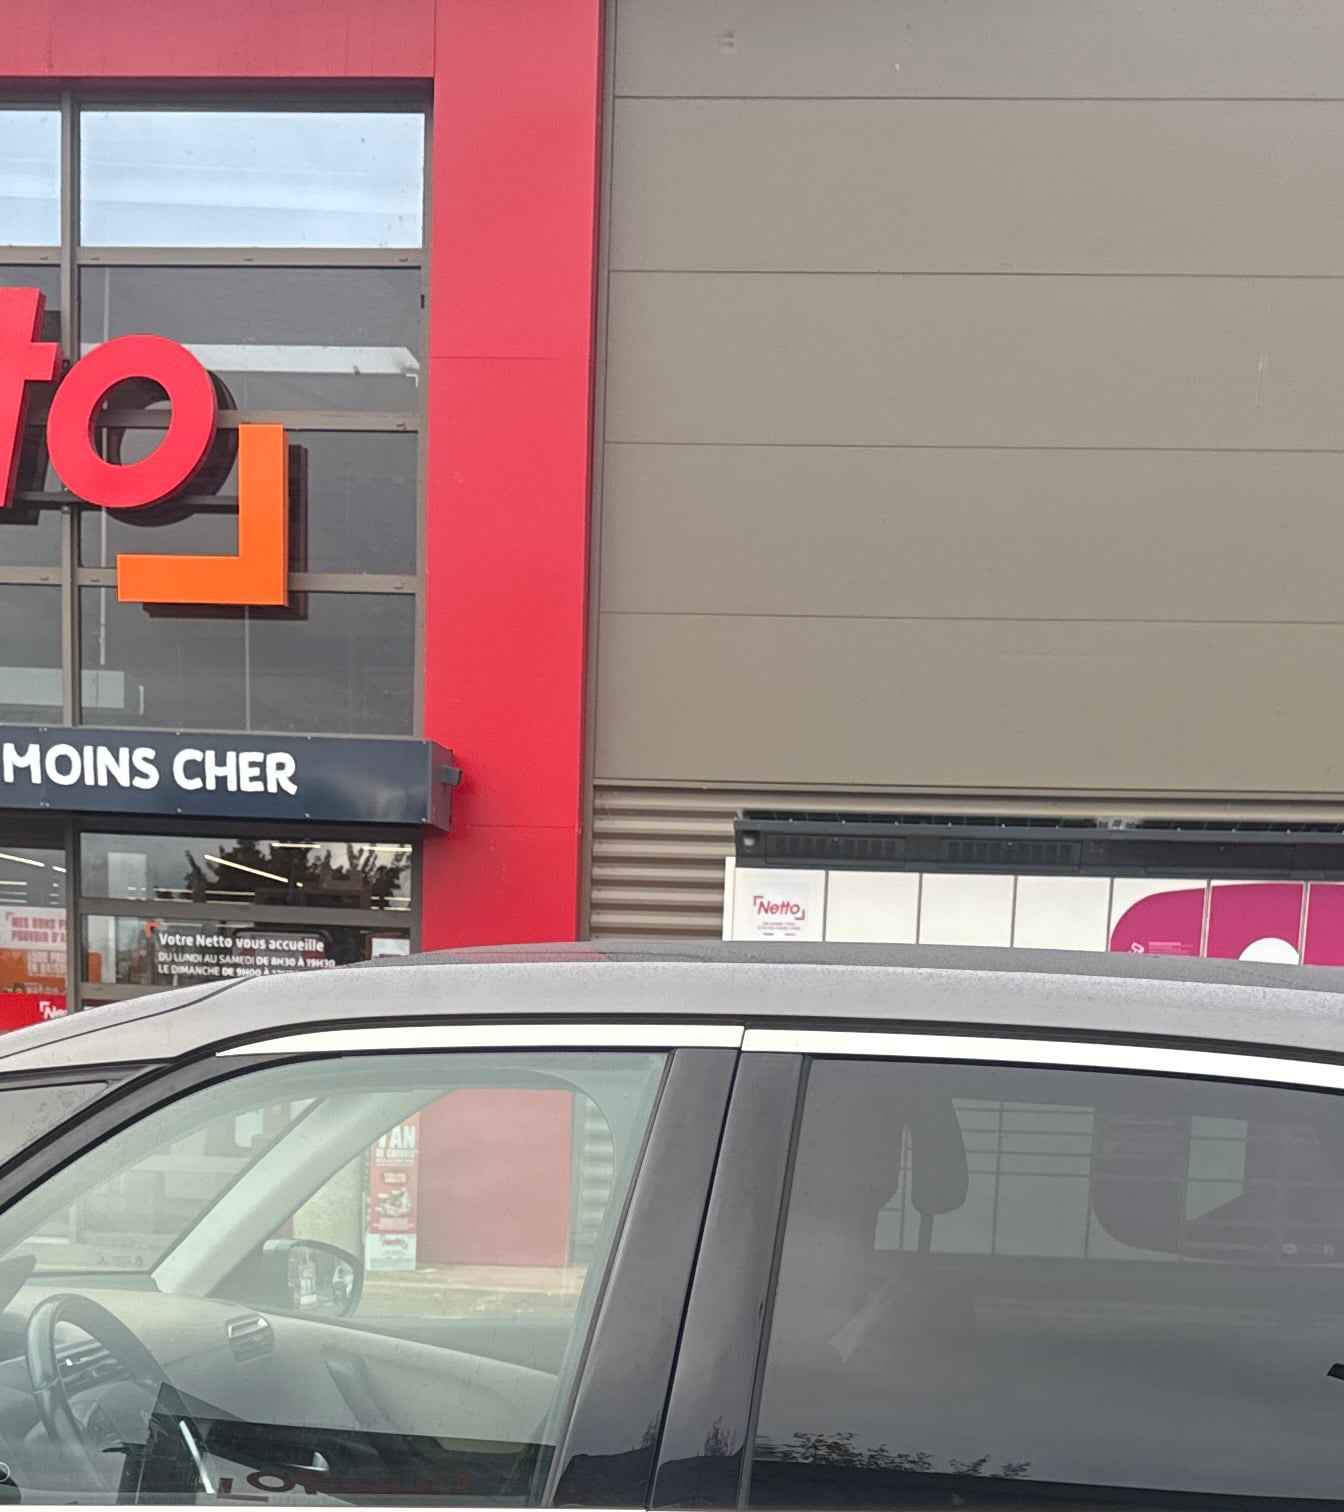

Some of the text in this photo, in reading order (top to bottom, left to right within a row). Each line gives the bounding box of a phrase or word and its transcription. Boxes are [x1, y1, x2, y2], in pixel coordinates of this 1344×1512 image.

[2, 742, 160, 789] MOINS
[172, 748, 298, 795] CHER
[757, 900, 800, 915] Netto
[159, 932, 325, 952] Votre Netto vous accueille
[158, 951, 172, 962] DU
[173, 952, 203, 963] LUNDI
[204, 953, 218, 964] AU
[219, 954, 255, 965] SAMEDI
[256, 956, 269, 966] DE
[297, 955, 305, 968] À
[158, 964, 169, 974] LE
[171, 965, 221, 976] DIMANCHE
[222, 967, 235, 977] DE
[389, 1125, 416, 1149] AN
